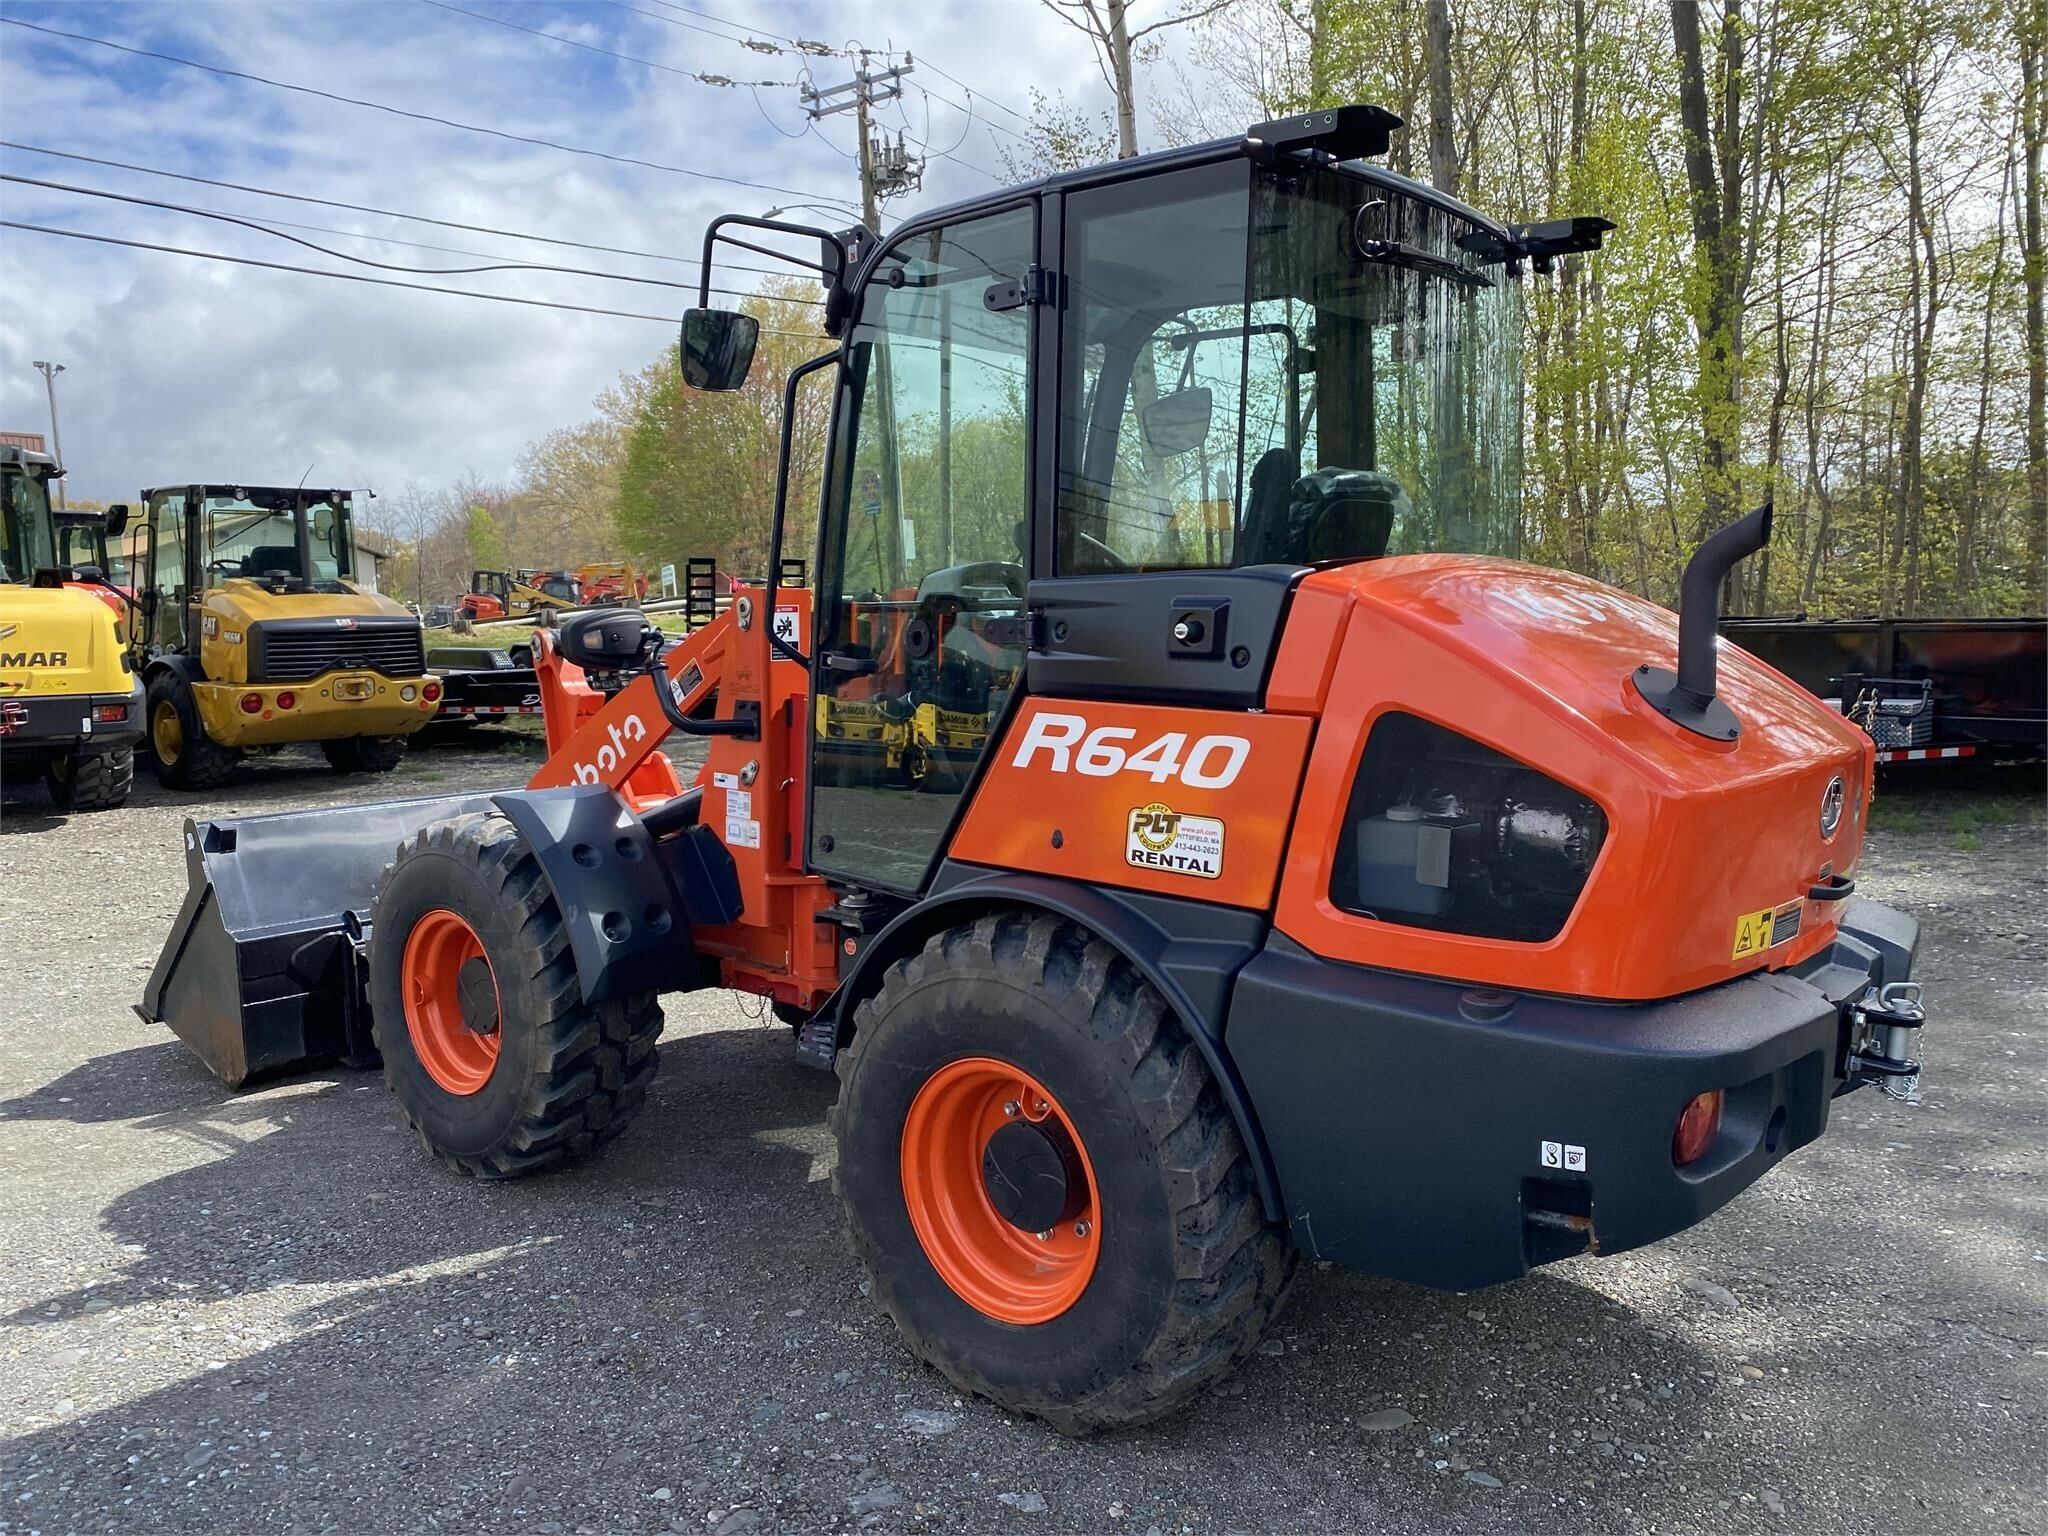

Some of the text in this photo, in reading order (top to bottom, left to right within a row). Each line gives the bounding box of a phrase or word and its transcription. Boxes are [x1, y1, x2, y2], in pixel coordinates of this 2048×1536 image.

[202, 616, 217, 636] CAT
[335, 618, 352, 627] CAT
[1011, 711, 1251, 790] R640
[1147, 804, 1169, 813] HEAVY
[1132, 813, 1182, 834] PLT
[1139, 833, 1173, 850] EQUIPMENT
[1177, 833, 1210, 844] PITTSFIELD,
[1174, 841, 1219, 856] 413-443-2623
[1131, 849, 1215, 873] RENTAL
